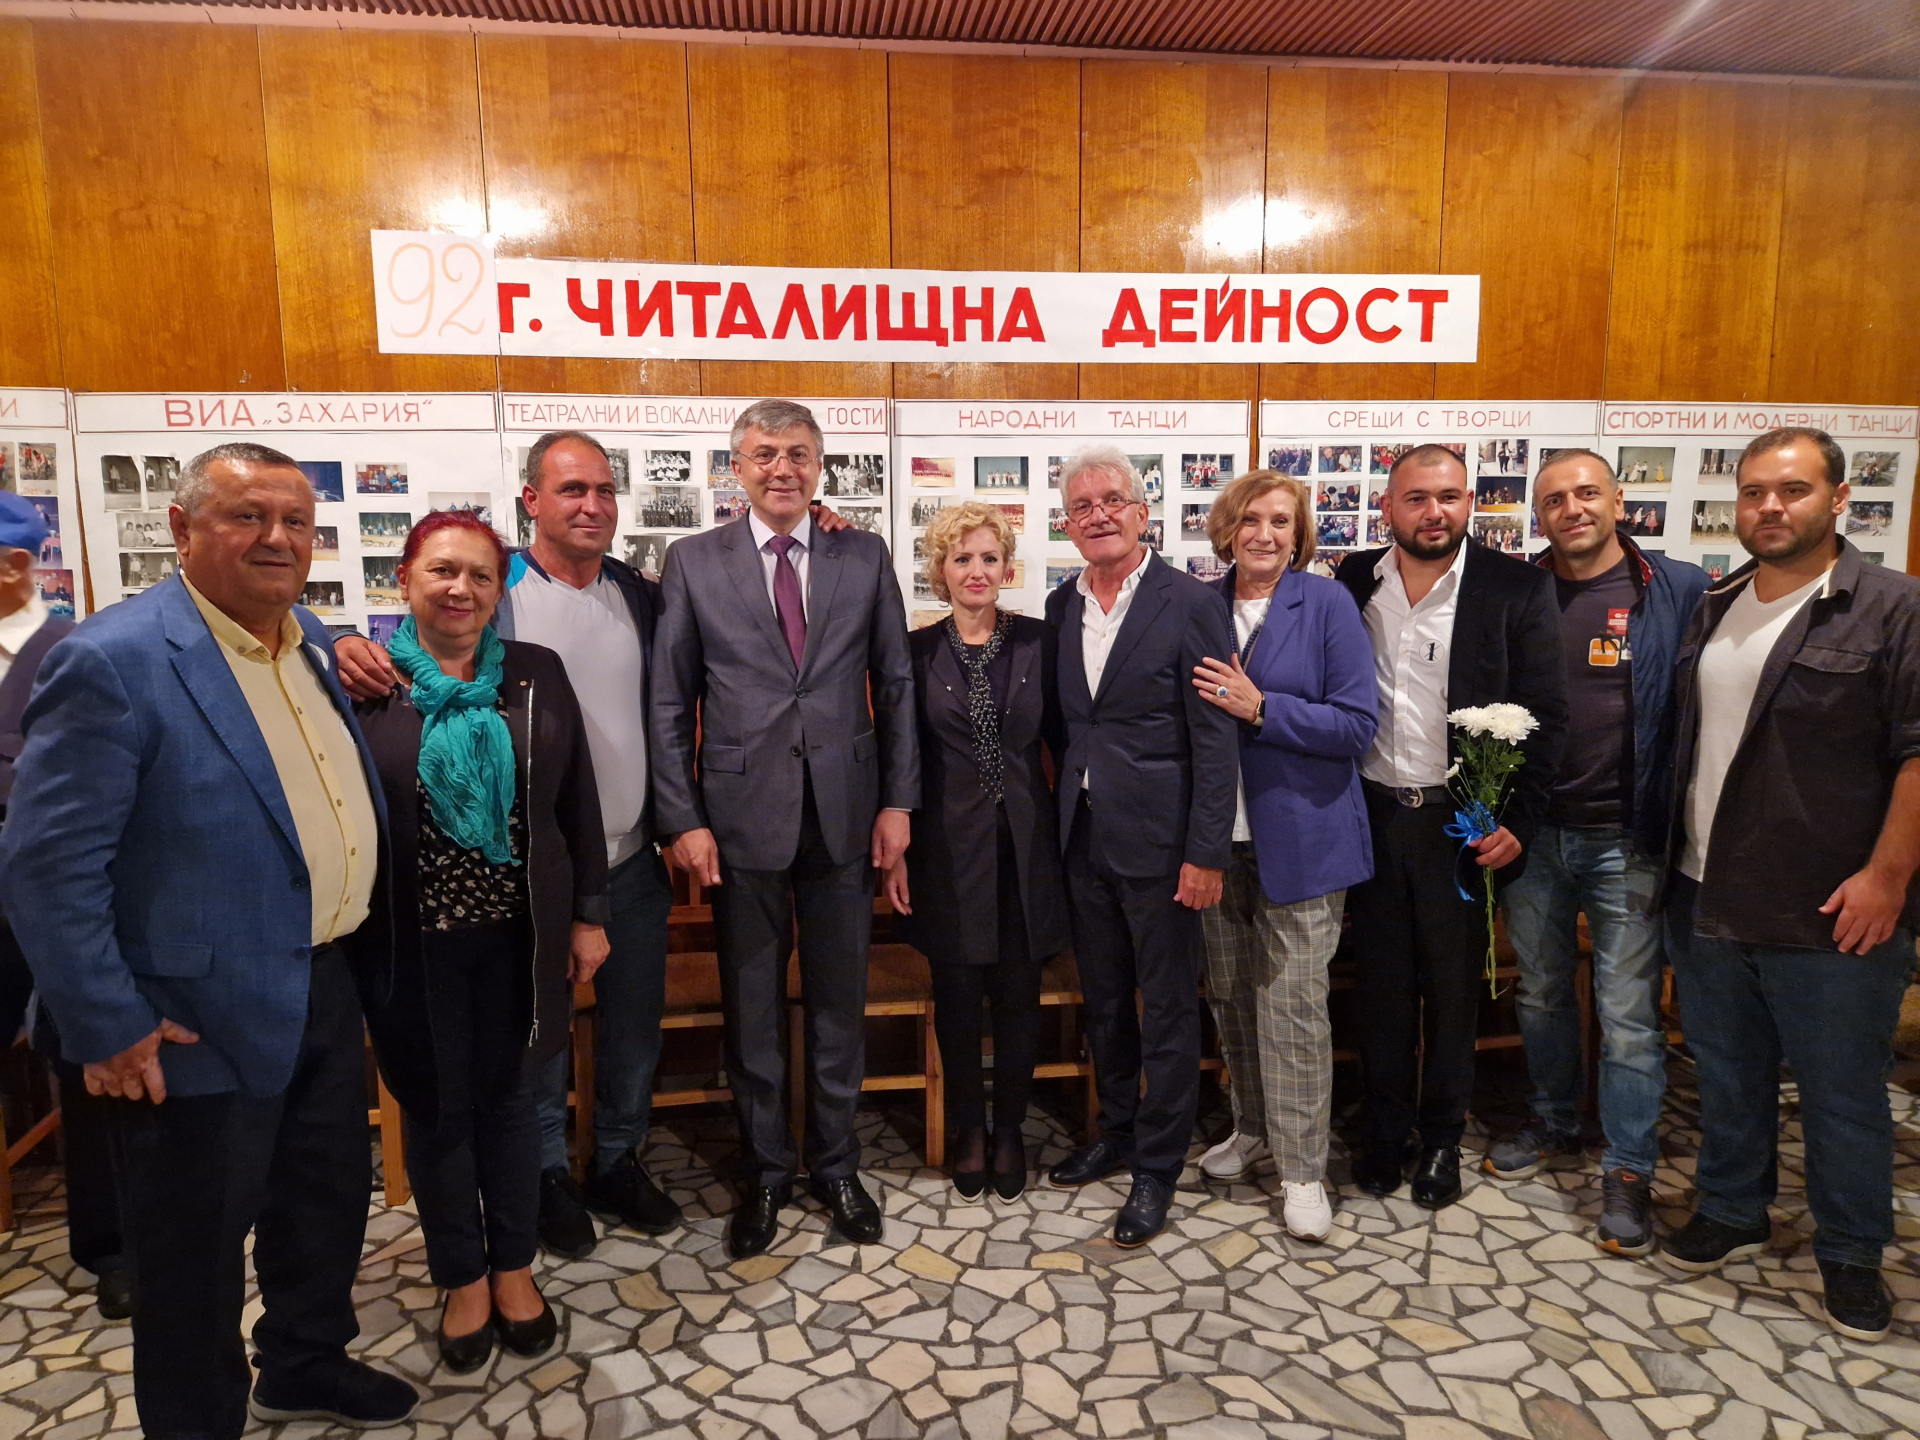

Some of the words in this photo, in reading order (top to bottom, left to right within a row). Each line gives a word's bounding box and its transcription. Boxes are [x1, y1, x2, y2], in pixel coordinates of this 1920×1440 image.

[388, 243, 485, 338] 92
[566, 278, 1047, 348] ЧИТАЛИЩНА
[1101, 275, 1449, 348] ДЕЙНОСТ
[164, 399, 256, 428] ВИА
[506, 403, 620, 424] ТЕАТРАЛНИ
[626, 405, 640, 424] И
[645, 406, 736, 425] ВОКАЛНИ
[827, 406, 883, 426] ГОСТИ
[958, 409, 1076, 430] НАРОДНИ
[1108, 410, 1187, 430] ТАНЦИ
[1327, 410, 1403, 429] СРЕЩИ
[1416, 410, 1430, 428] С
[1441, 410, 1531, 429] ТВОРЦИ
[1607, 410, 1706, 430] СПОРТНИ
[1712, 411, 1728, 430] И
[1733, 412, 1838, 431] МОДЕРНИ
[1847, 414, 1912, 434] ТАНЦИ
